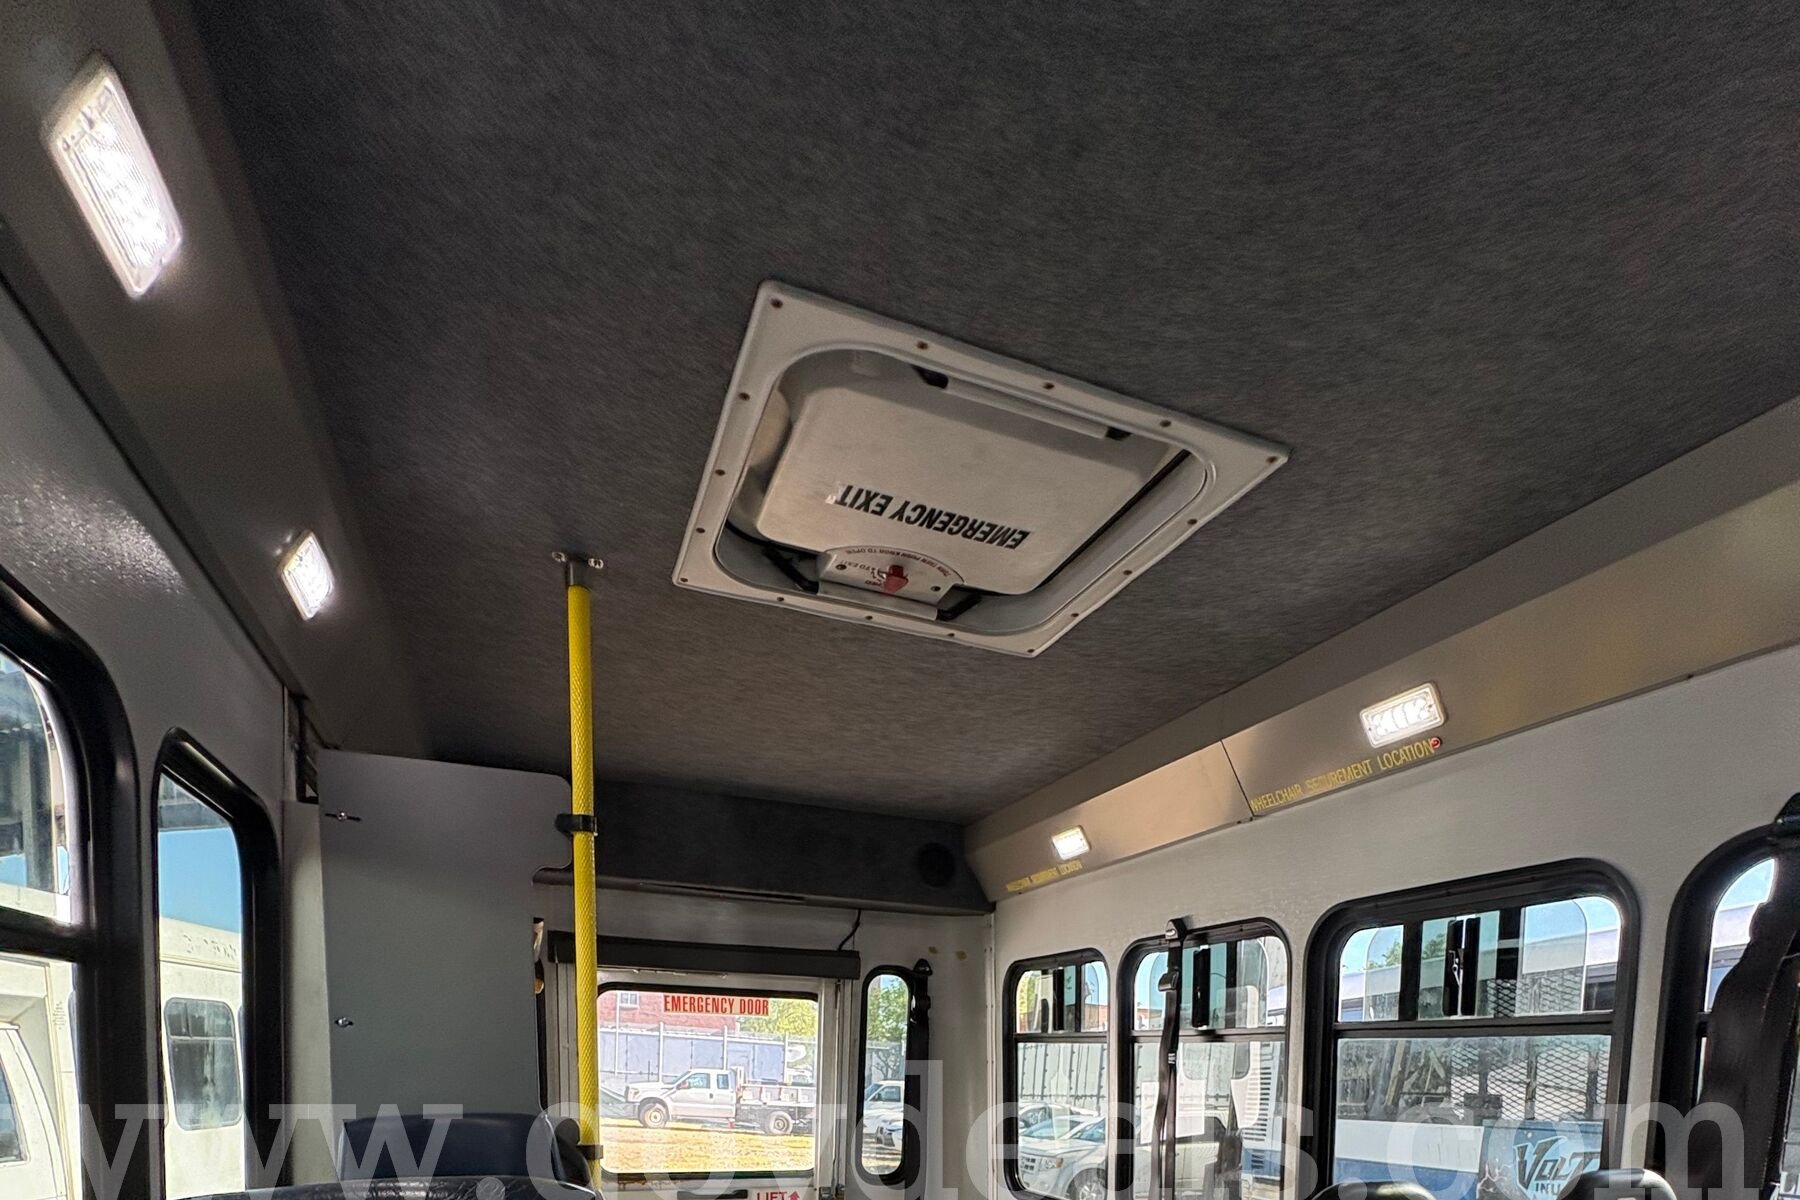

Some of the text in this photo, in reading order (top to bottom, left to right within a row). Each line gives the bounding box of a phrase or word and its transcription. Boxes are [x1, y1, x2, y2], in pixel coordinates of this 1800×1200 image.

[834, 485, 1031, 550] EMERGENCY EXIT
[1250, 738, 1435, 812] WHEELCHAIR SECUREMENT LOCATION
[663, 995, 769, 1016] EMERGENCY DOOR
